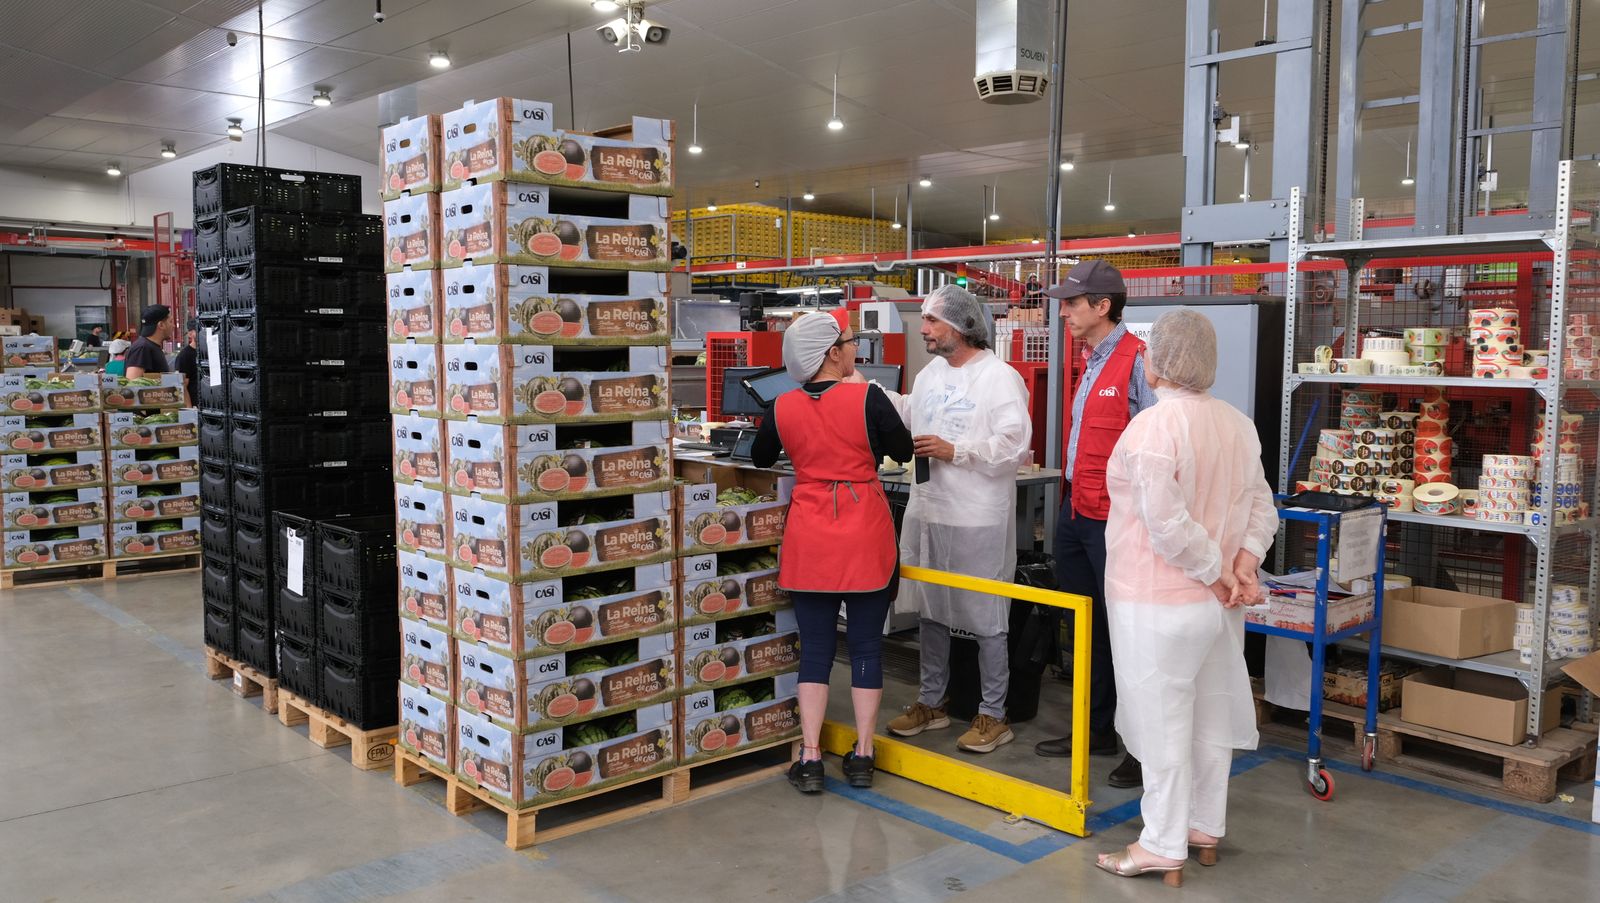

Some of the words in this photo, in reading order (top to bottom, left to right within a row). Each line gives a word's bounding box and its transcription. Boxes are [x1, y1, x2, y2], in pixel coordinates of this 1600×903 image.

[524, 109, 543, 121] CASI
[600, 153, 616, 166] La
[617, 155, 650, 170] Reina
[519, 192, 539, 203] CASI
[596, 233, 610, 244] La
[613, 233, 647, 246] Reina
[521, 274, 541, 285] CASI
[597, 308, 611, 320] La
[614, 308, 647, 320] Reina
[525, 355, 545, 364] CASI
[599, 385, 614, 397] La
[616, 384, 648, 396] Reina
[1098, 388, 1116, 396] CASI
[529, 432, 549, 442] CASI
[602, 460, 615, 472] La
[618, 457, 651, 470] Reina
[693, 491, 710, 501] CASI
[532, 511, 550, 521] CASI
[753, 515, 764, 526] La
[604, 533, 618, 545] La
[620, 530, 652, 542] Reina
[695, 561, 711, 571] CASI
[753, 582, 764, 592] La
[535, 588, 554, 598] CASI
[607, 607, 621, 620] La
[623, 602, 655, 616] Reina
[694, 631, 709, 640] CASI
[752, 649, 764, 660] La
[765, 644, 792, 657] Reina
[539, 661, 558, 673] CASI
[610, 679, 623, 691] La
[625, 672, 656, 687] Reina
[694, 699, 708, 709] CASI
[752, 716, 763, 727] La
[765, 710, 792, 724] Reina
[537, 736, 555, 746] CASI
[371, 746, 390, 758] EPAL
[607, 750, 620, 763] La
[622, 744, 654, 758] Reina
